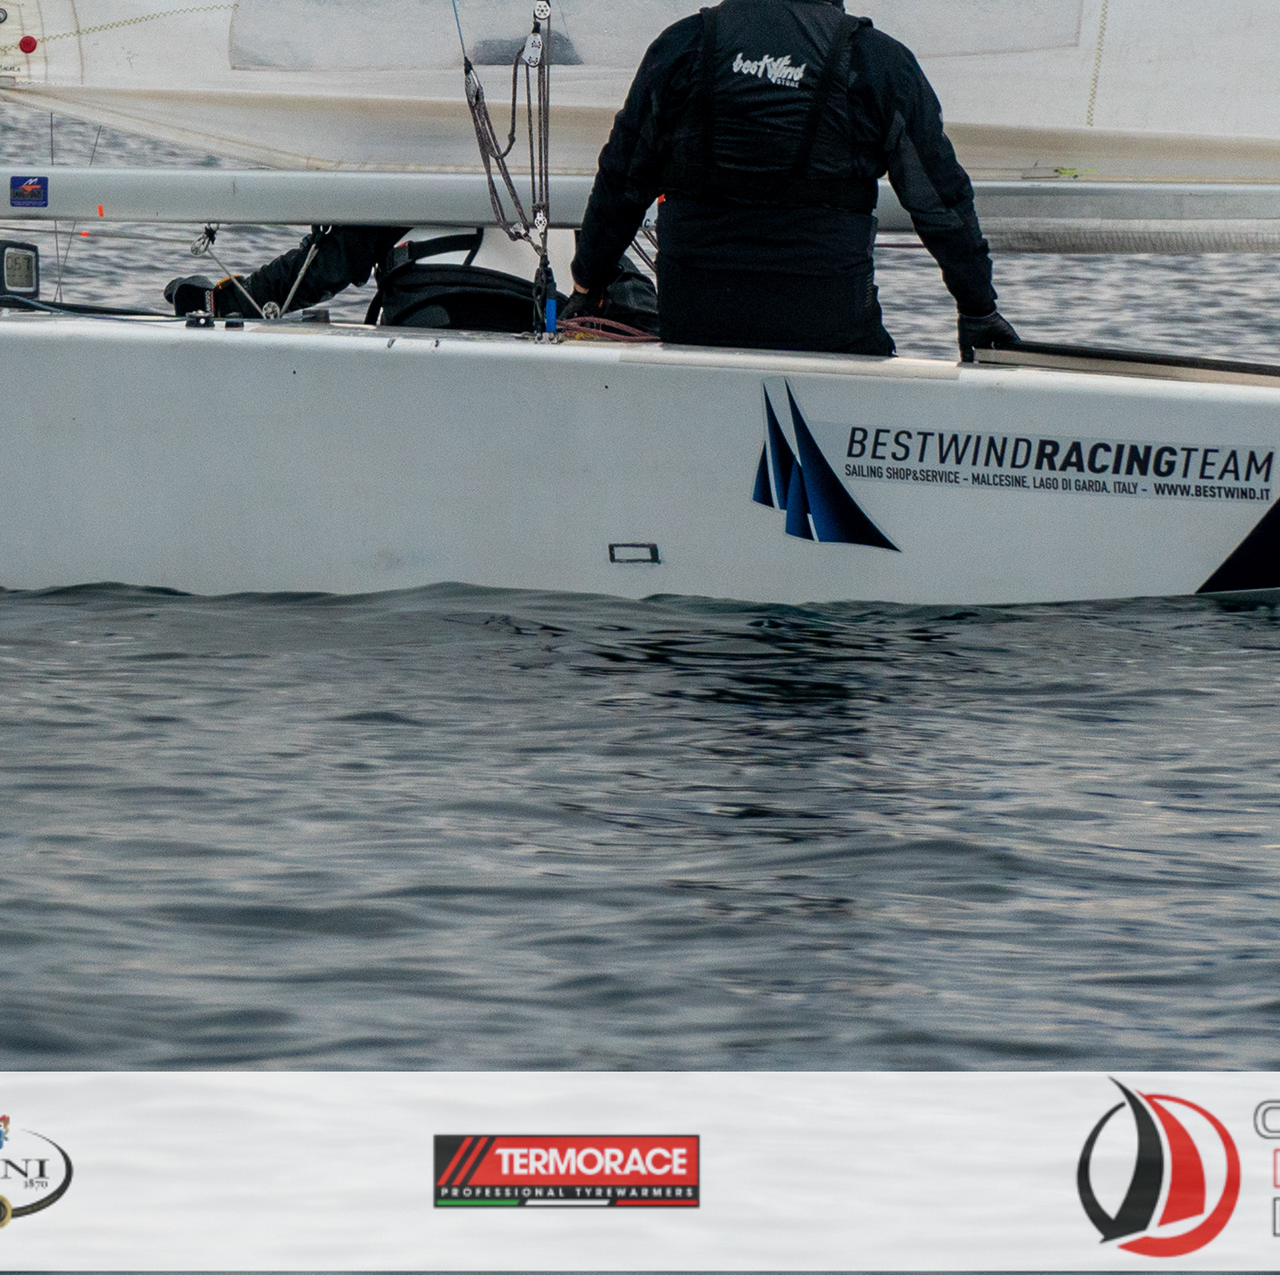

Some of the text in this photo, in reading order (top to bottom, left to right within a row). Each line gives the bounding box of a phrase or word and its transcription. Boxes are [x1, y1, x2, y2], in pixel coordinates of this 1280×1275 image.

[845, 464, 884, 479] SAILING
[886, 467, 960, 485] SHOP&SERVICE
[1032, 477, 1059, 491] LAGO
[1061, 480, 1072, 491] DI
[1113, 482, 1138, 495] ITALY
[1153, 482, 1271, 502] WWW.BESTWIND.IT
